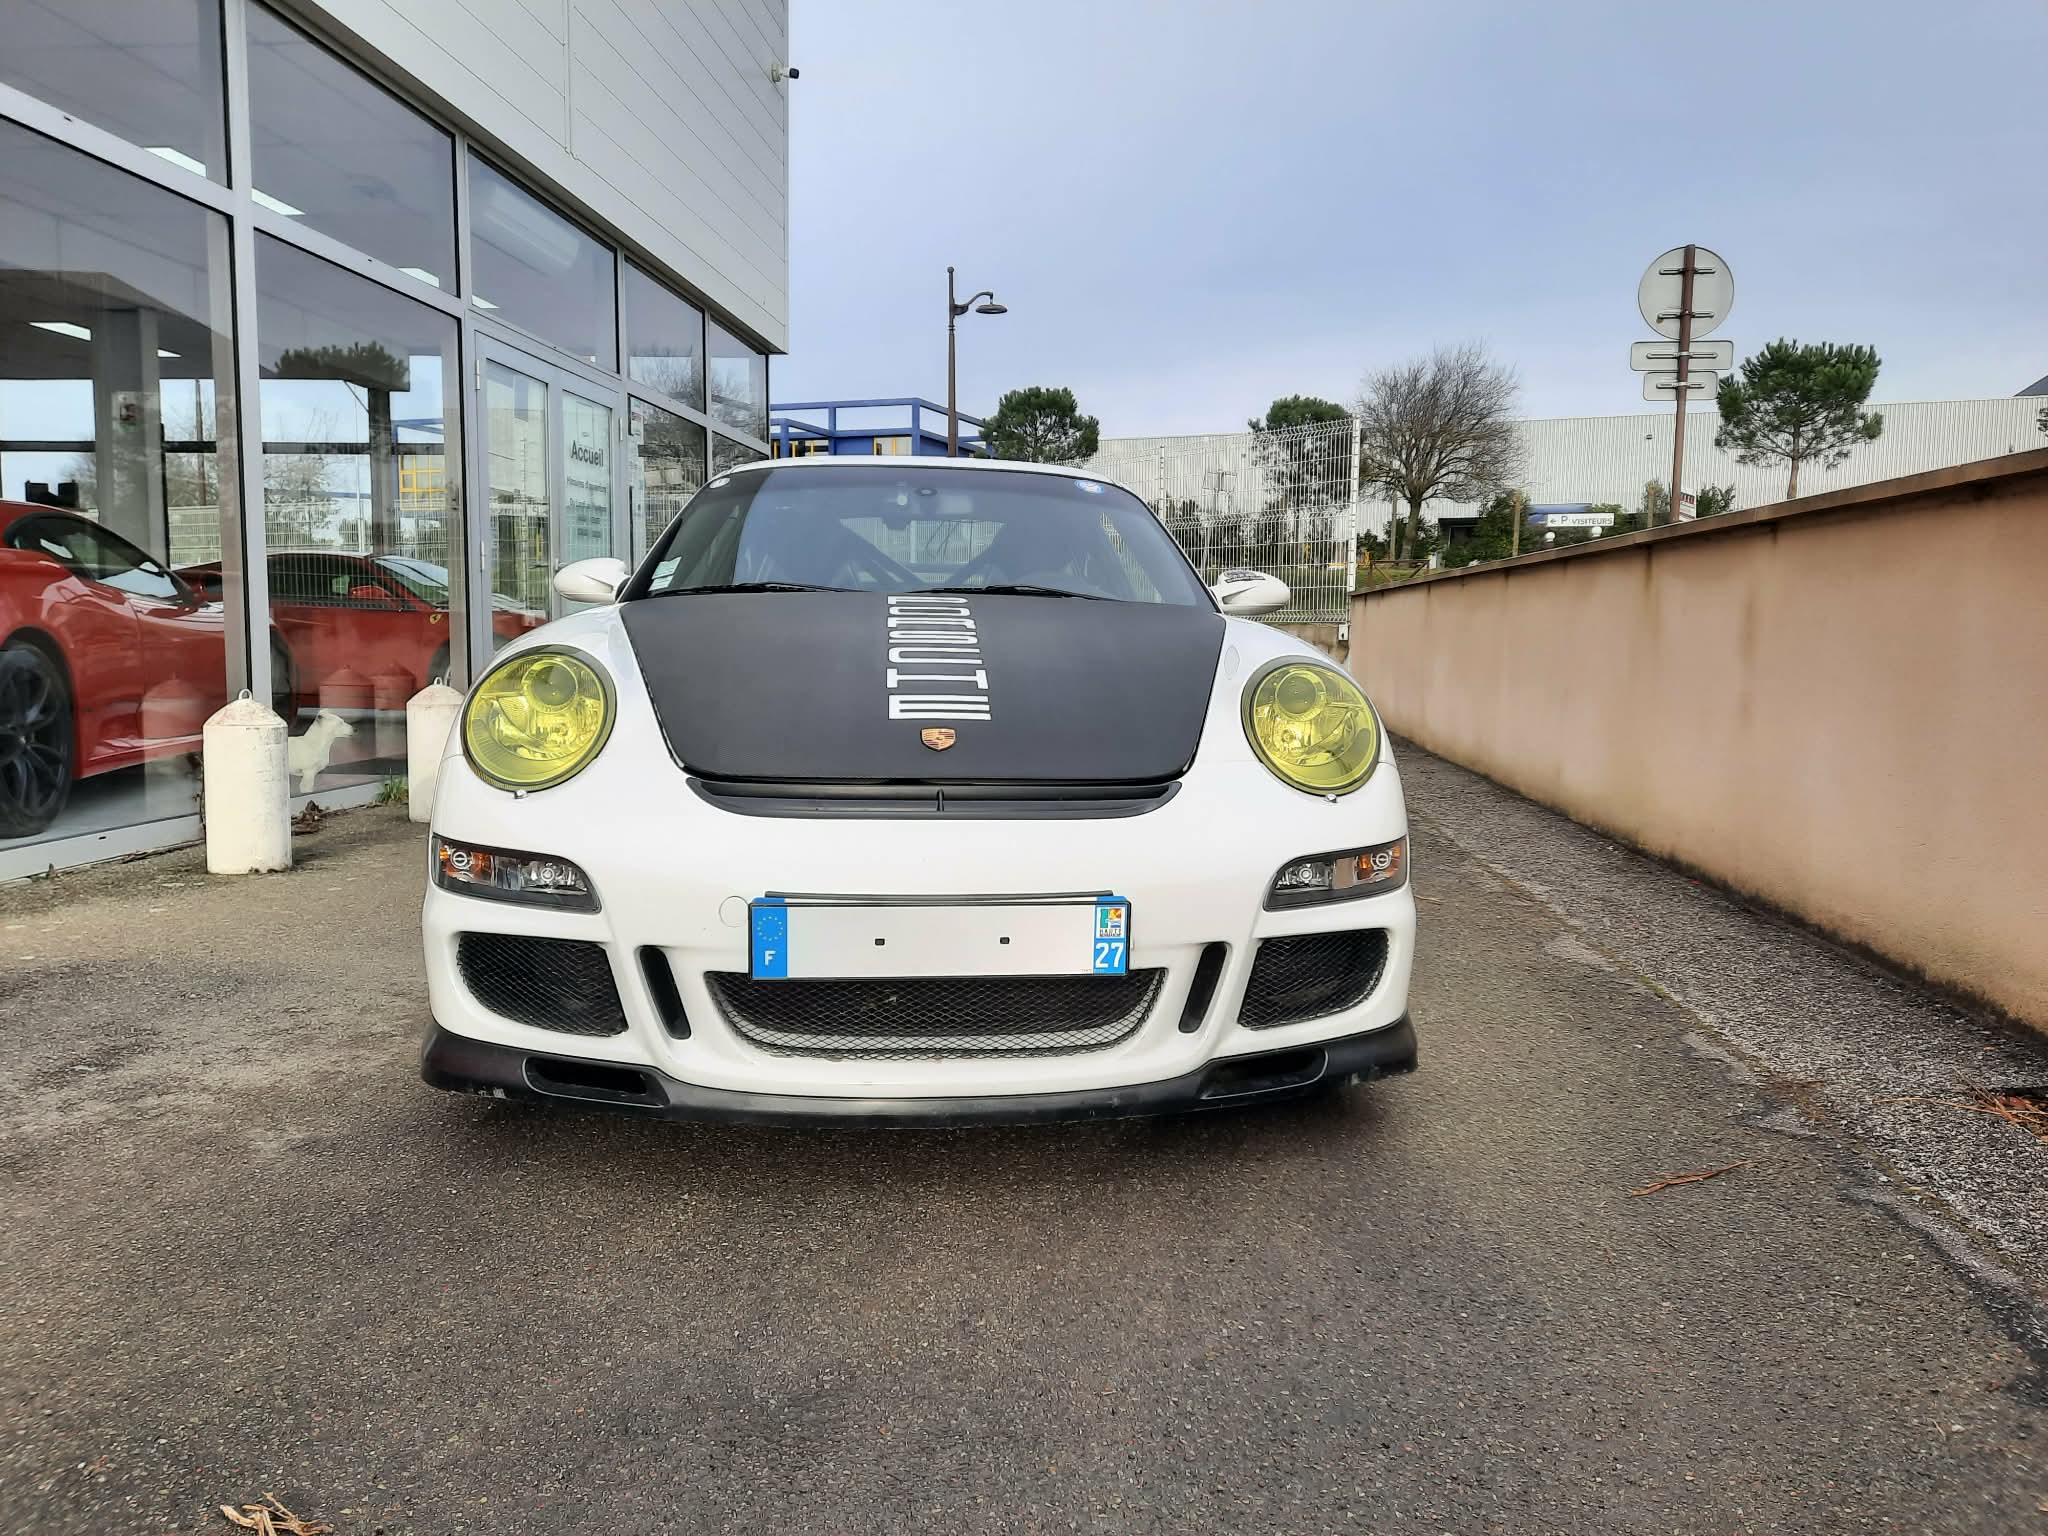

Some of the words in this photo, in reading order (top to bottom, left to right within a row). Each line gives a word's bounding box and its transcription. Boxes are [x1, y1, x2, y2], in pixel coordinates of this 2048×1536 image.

[570, 439, 604, 467] Accueil
[1561, 515, 1568, 524] P
[1571, 517, 1612, 525] VISITEURS
[886, 595, 992, 721] PORSCHE
[764, 950, 777, 966] F
[1095, 942, 1124, 968] 27
